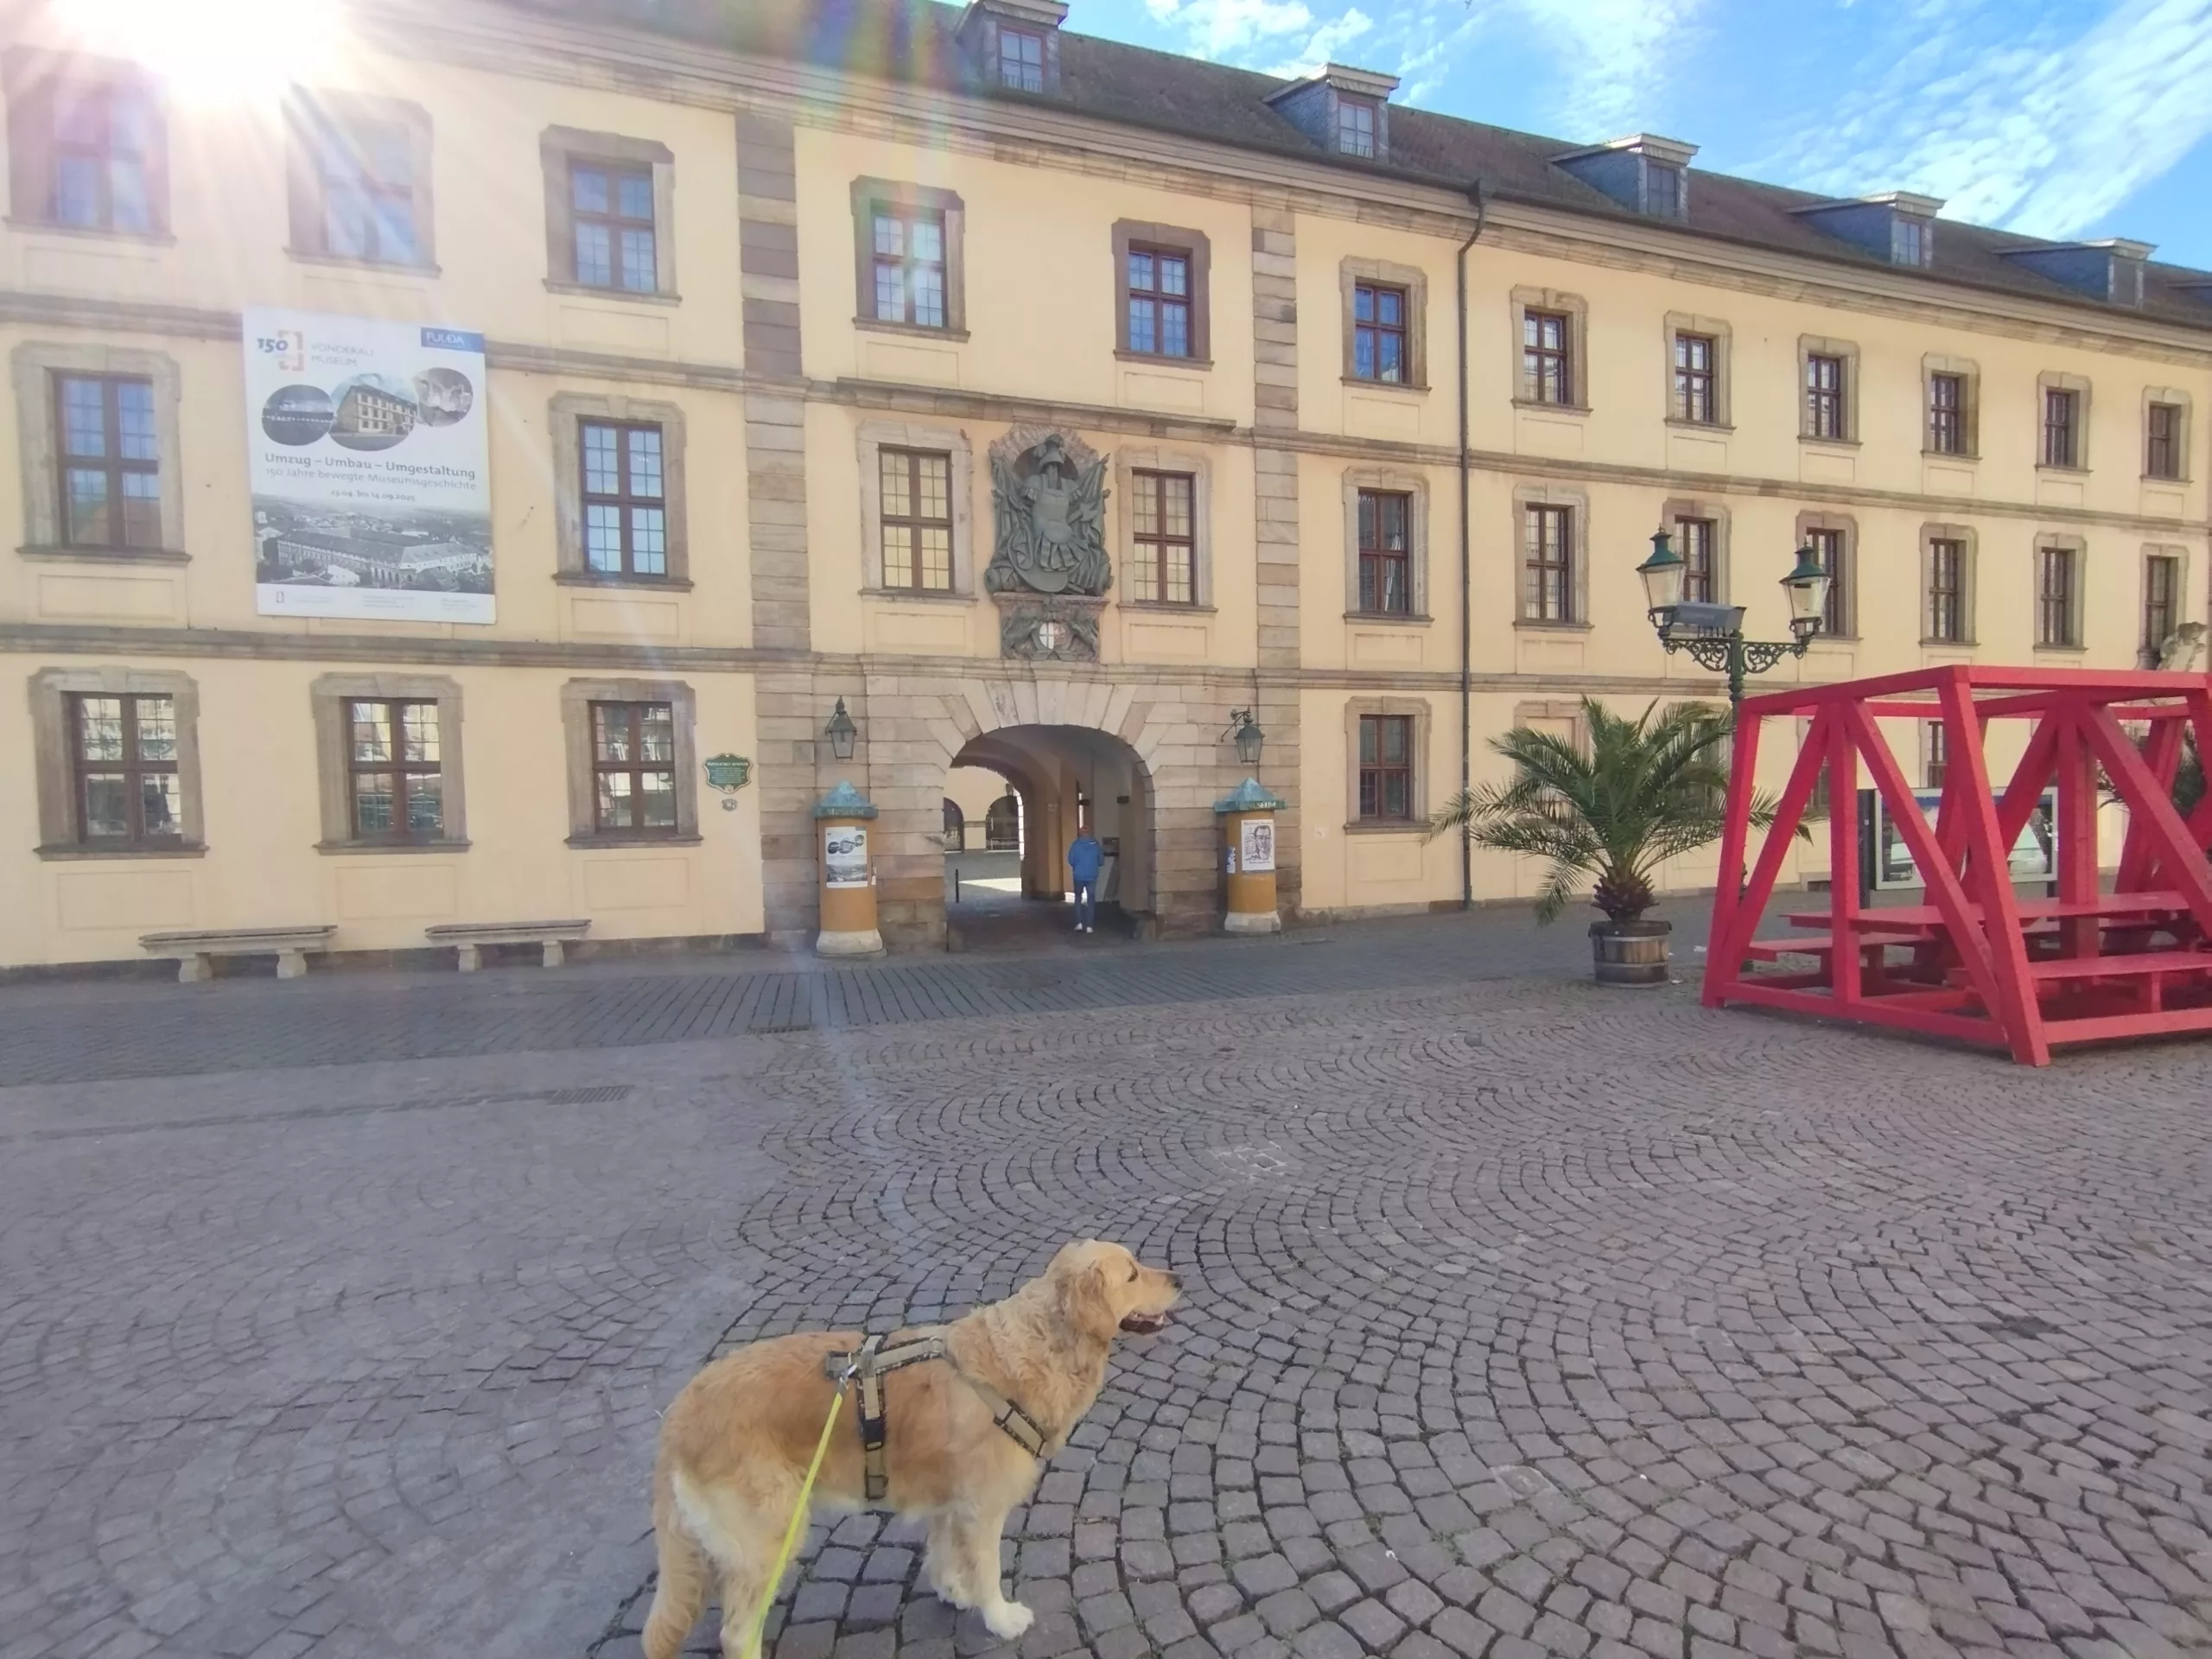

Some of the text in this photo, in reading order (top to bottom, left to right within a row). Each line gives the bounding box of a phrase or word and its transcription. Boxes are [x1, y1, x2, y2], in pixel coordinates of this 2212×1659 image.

[257, 338, 289, 353] 150
[311, 355, 357, 366] MUSEUM
[265, 453, 311, 467] Umzug
[325, 456, 372, 469] Umbau
[385, 461, 476, 480] Umgestaltung
[266, 468, 476, 490] 150 Jahre bewegte Museumsgeschichte
[357, 489, 369, 498] bis
